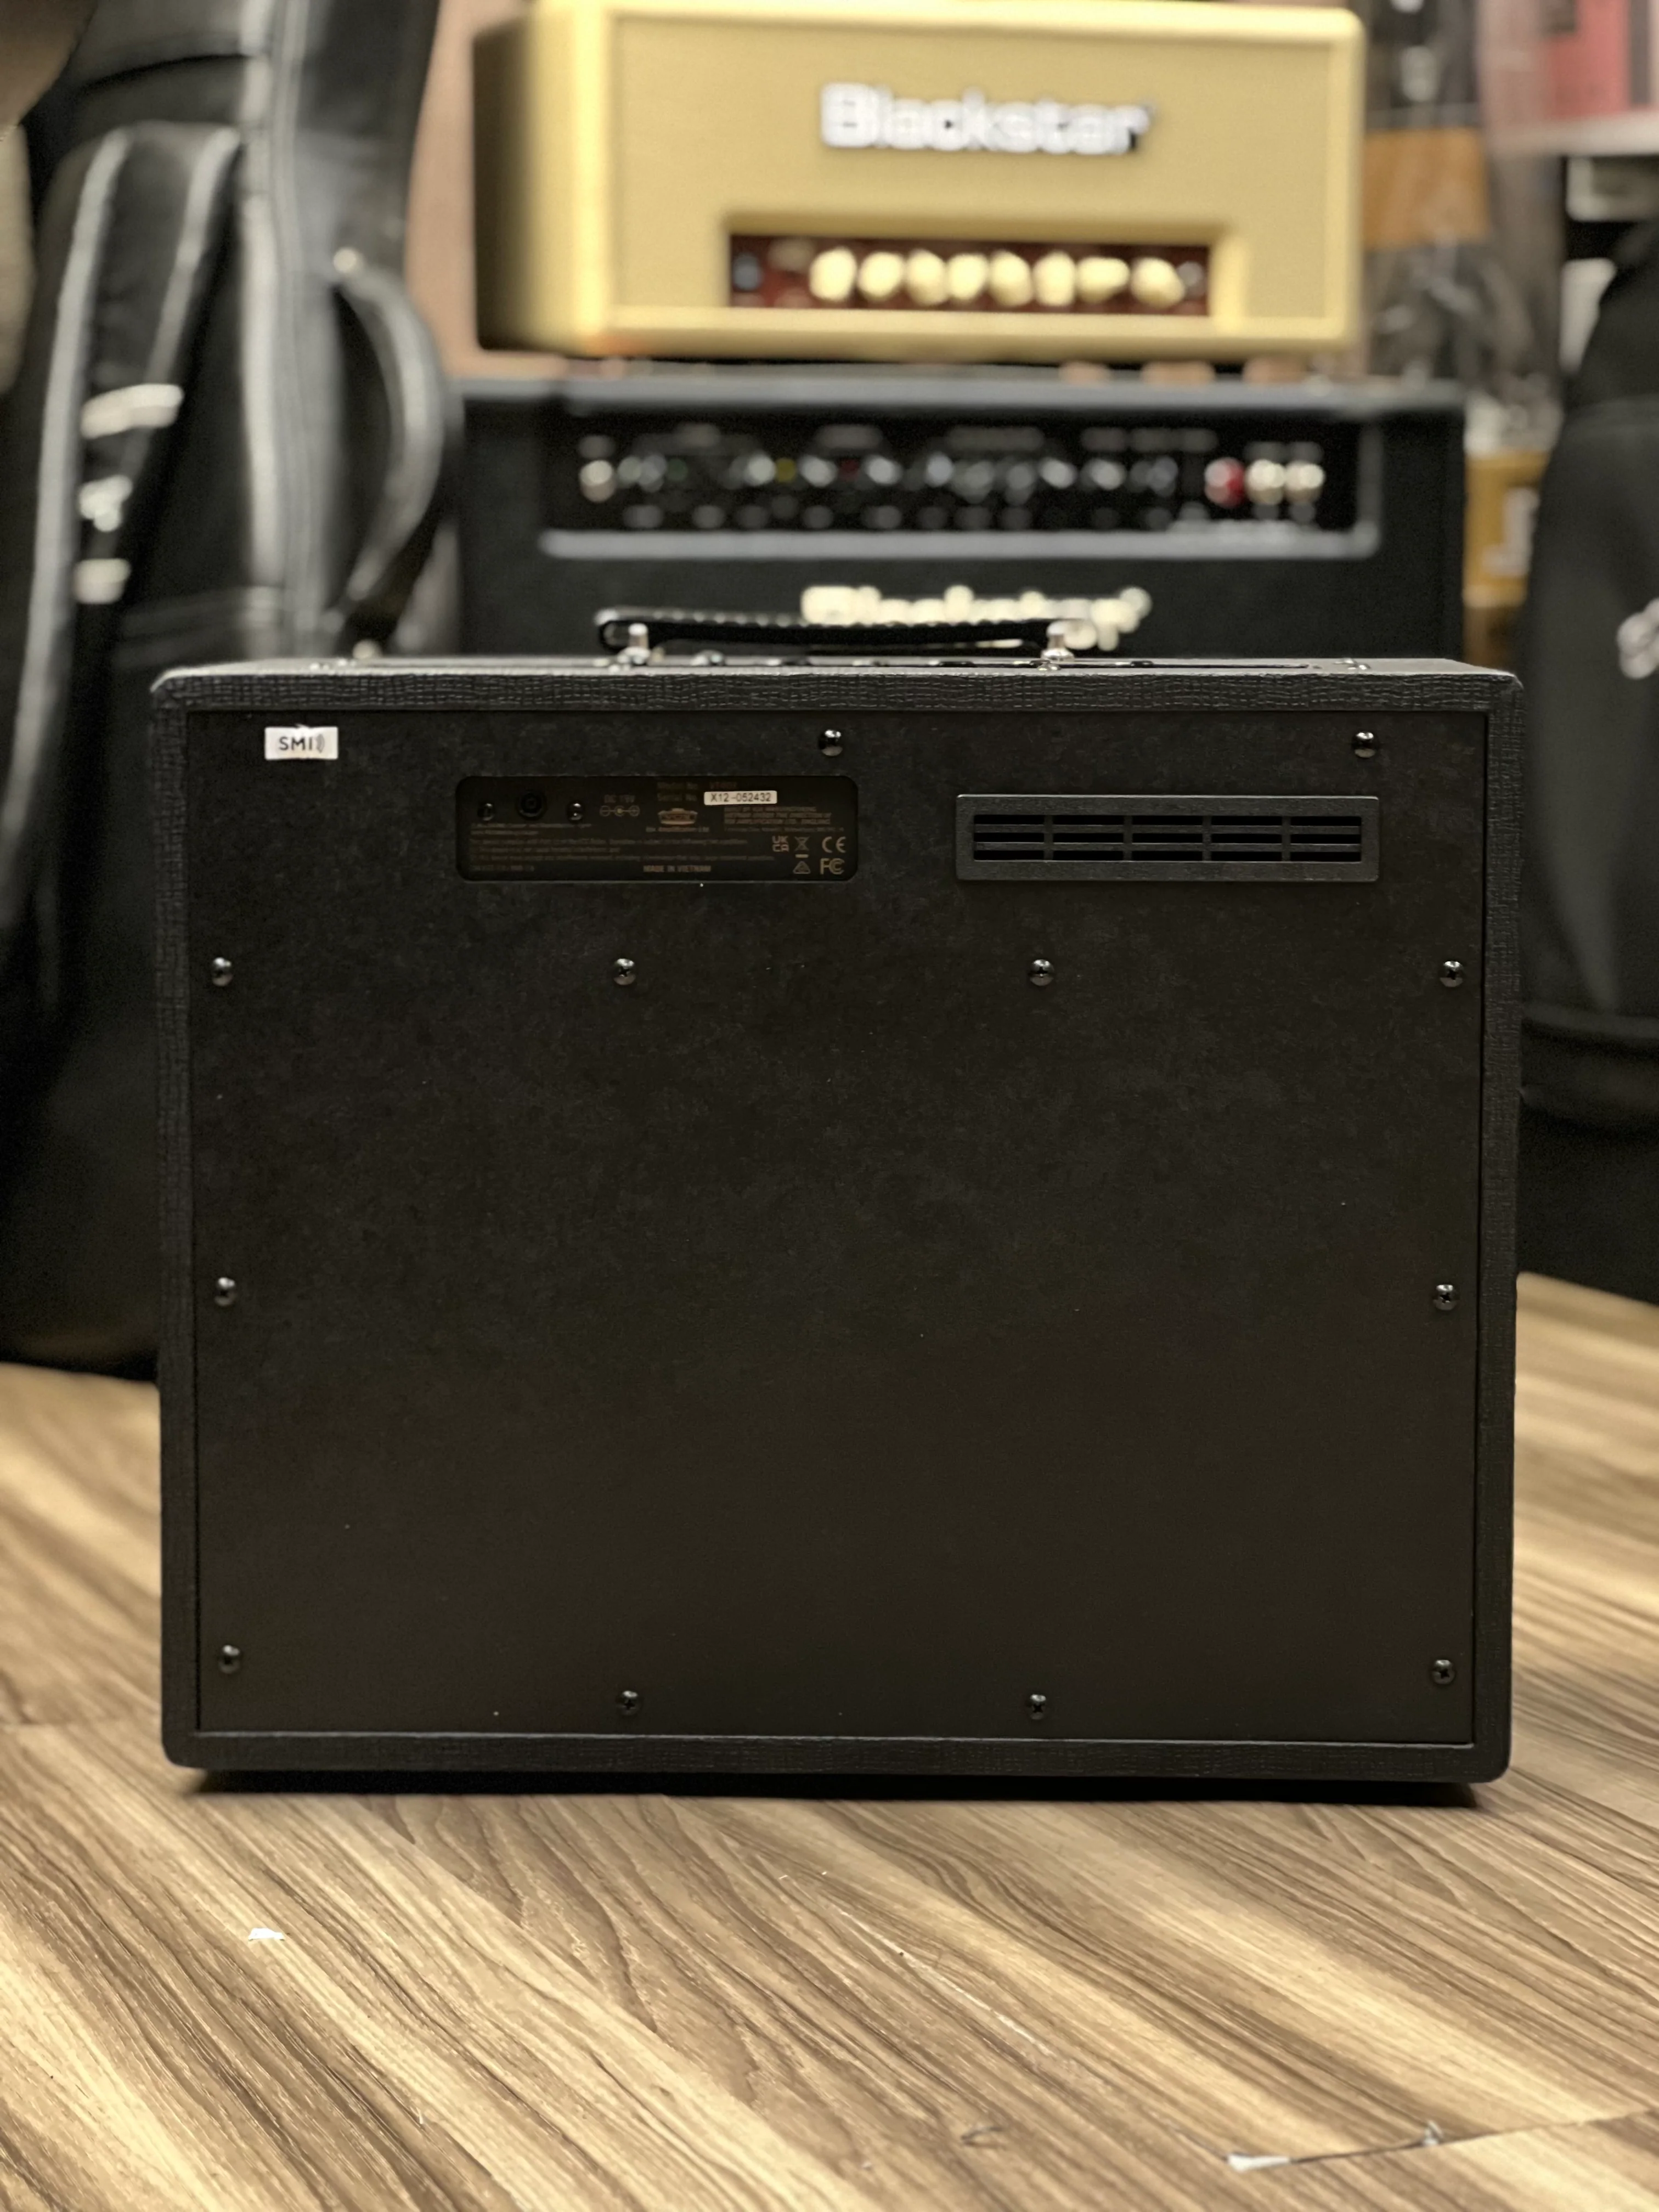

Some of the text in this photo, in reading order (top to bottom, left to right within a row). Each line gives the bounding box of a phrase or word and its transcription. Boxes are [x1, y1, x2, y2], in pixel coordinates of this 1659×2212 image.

[821, 82, 1154, 155] Blackstar
[711, 793, 771, 802] X12-052432
[772, 836, 788, 844] UK
